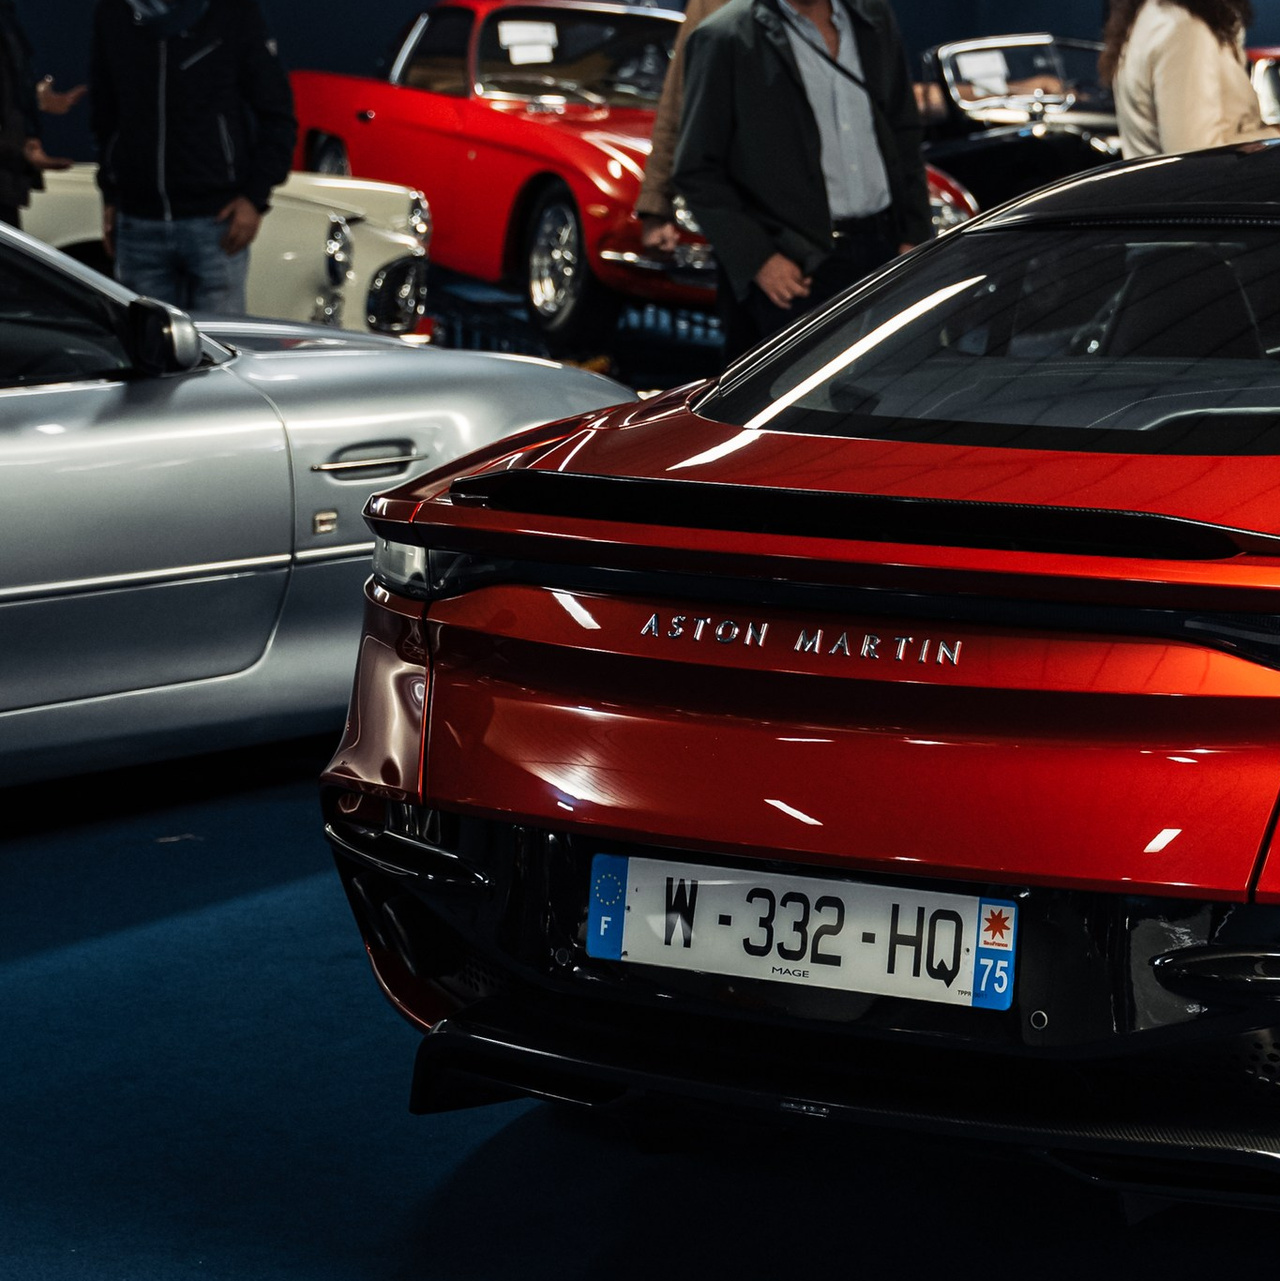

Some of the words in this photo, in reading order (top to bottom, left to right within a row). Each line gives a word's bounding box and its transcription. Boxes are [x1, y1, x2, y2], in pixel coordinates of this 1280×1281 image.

[640, 612, 770, 647] ASTON
[793, 628, 963, 666] MARTIN
[600, 916, 612, 936] F
[771, 966, 810, 979] MAGE
[980, 958, 1009, 993] 75
